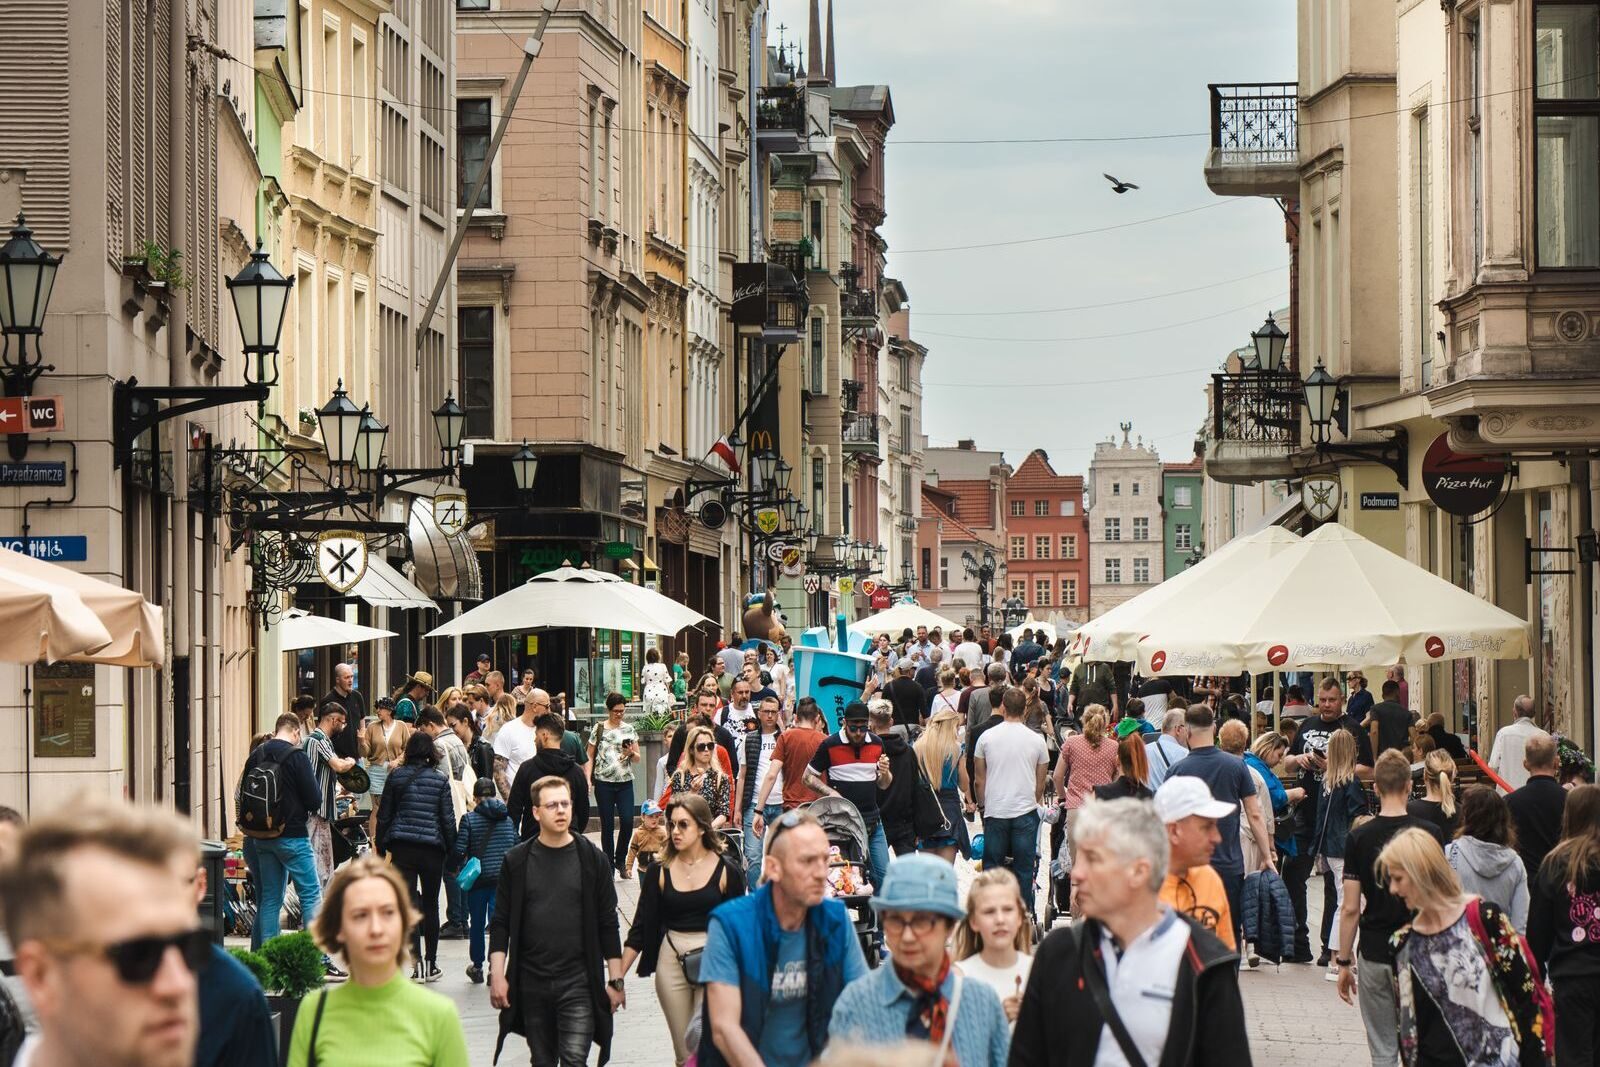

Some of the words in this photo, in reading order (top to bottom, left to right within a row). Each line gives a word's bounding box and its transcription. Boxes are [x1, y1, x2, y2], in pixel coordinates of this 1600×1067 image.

[32, 408, 54, 420] WC
[2, 465, 63, 481] Przedzamcze
[1435, 476, 1467, 490] Pizza
[1469, 477, 1495, 489] Hut
[1363, 496, 1398, 507] Podmurna
[1292, 643, 1338, 660] Pizza
[1338, 641, 1375, 657] Hut
